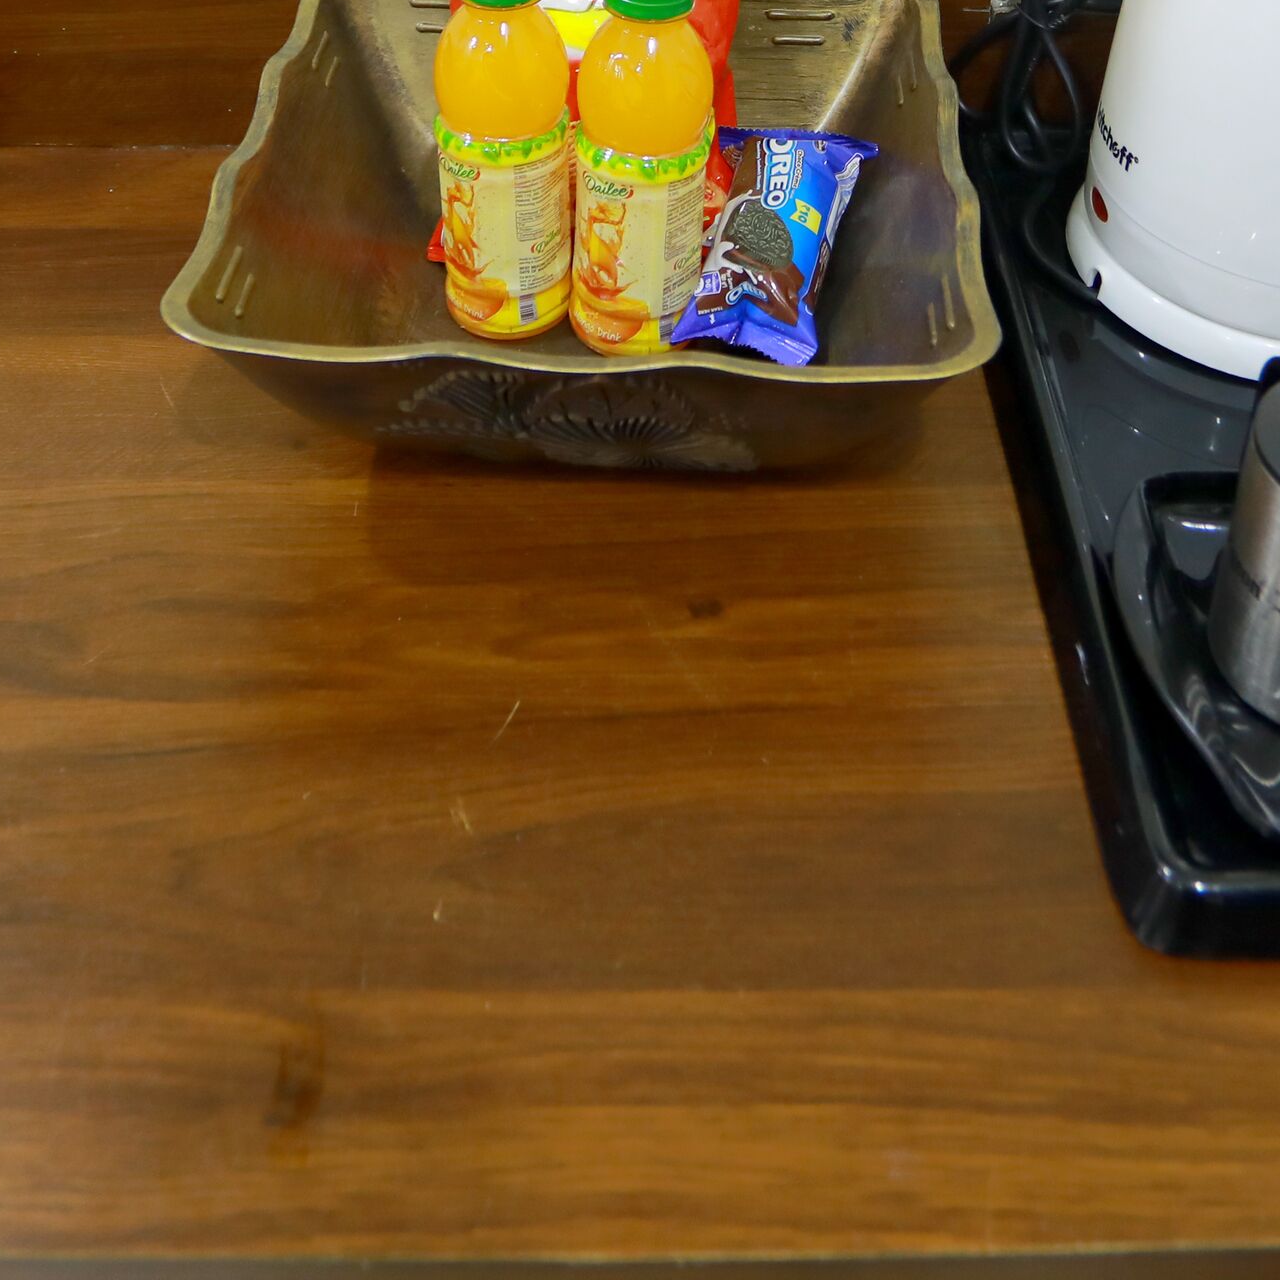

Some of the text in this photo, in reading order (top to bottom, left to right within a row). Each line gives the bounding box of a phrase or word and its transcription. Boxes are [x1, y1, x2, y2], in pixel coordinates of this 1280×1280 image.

[766, 138, 793, 207] OREO
[584, 173, 629, 198] Dailee
[597, 327, 622, 343] Drink
